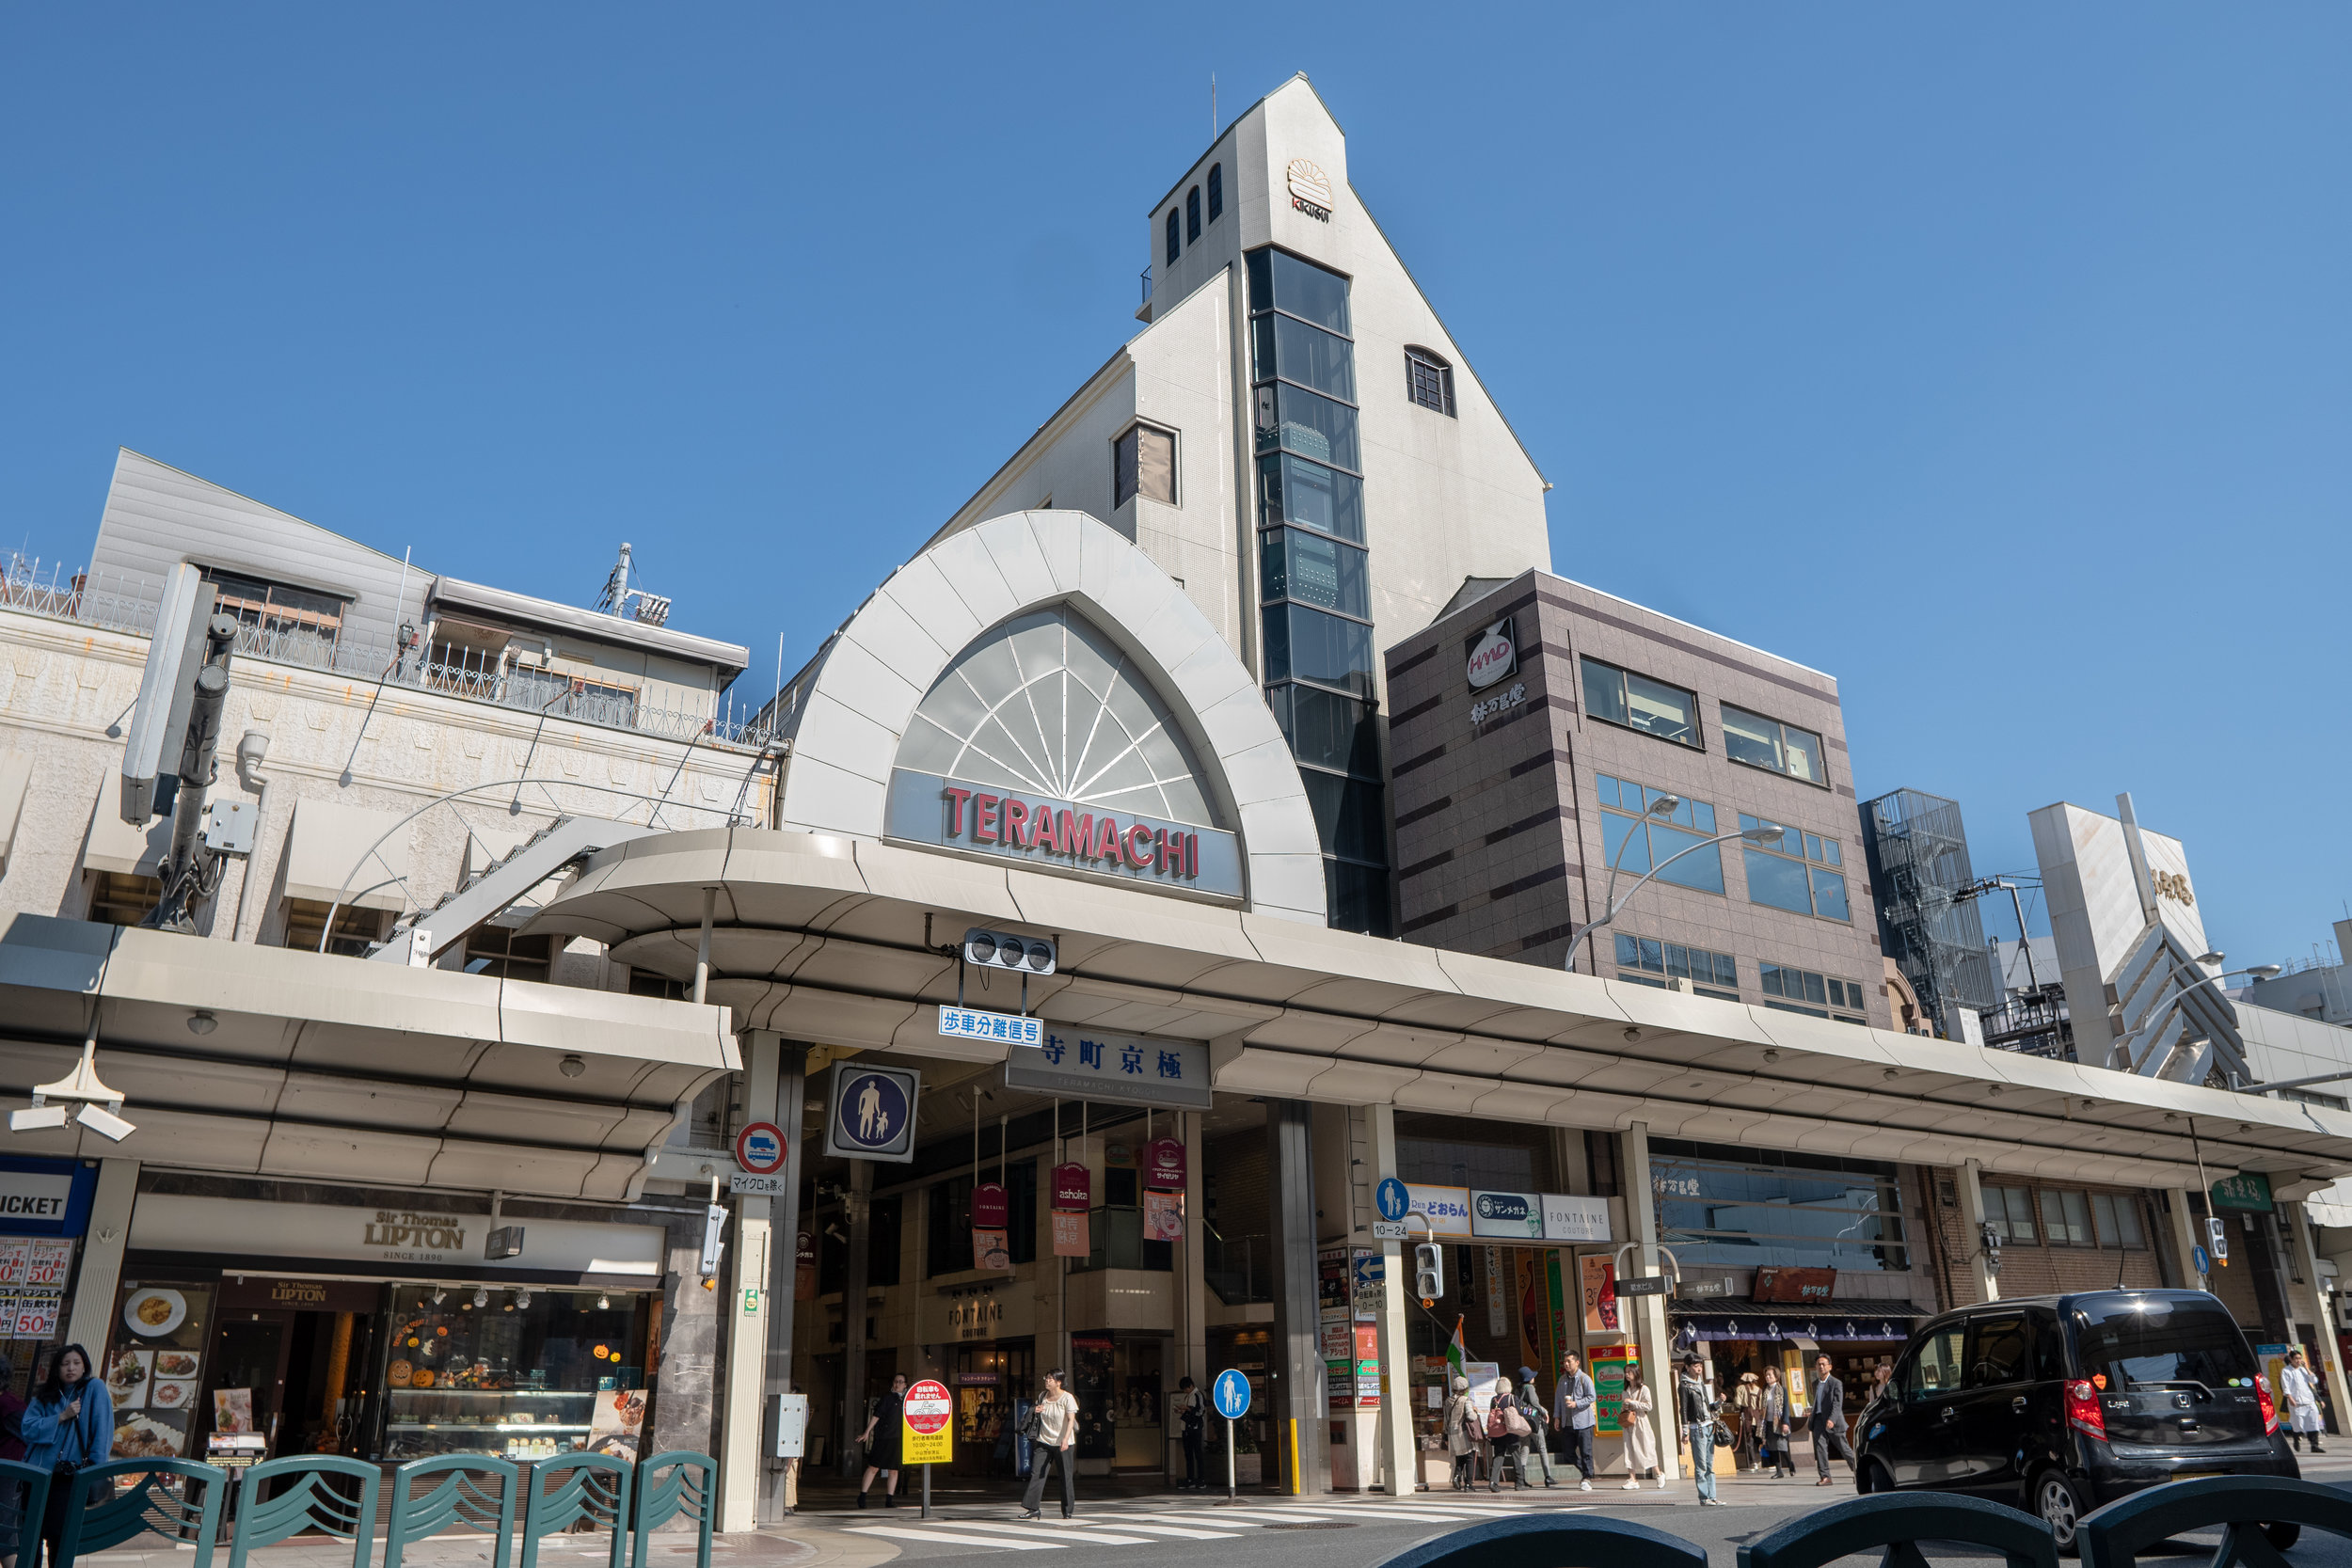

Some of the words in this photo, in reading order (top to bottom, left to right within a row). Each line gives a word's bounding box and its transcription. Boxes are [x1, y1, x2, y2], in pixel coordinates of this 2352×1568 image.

[1470, 641, 1510, 674] HMD
[946, 786, 1200, 879] TERAMACHI
[944, 1010, 1040, 1042] 歩車分離信号
[1041, 1035, 1183, 1080] 寺町京極
[733, 1176, 783, 1192] マイクロを除く
[1058, 1188, 1089, 1200] ashoka
[0, 1196, 63, 1215] ICKET
[1427, 1201, 1469, 1217] どおらん
[1494, 1205, 1527, 1215] サンメガネ
[375, 1211, 397, 1224] Sir
[402, 1212, 459, 1227] Thomas
[1549, 1212, 1604, 1224] FONTAINE
[364, 1223, 466, 1250] LIPTON
[1562, 1227, 1595, 1235] COUTURE
[383, 1251, 415, 1260] SINCE
[420, 1253, 442, 1261] 1890
[277, 1281, 290, 1290] Sir
[291, 1281, 323, 1290] Thomas
[271, 1288, 326, 1302] LIPTON
[1585, 1287, 1598, 1306] 3F
[22, 1299, 58, 1309] 缶飲料
[948, 1304, 1003, 1326] FONTAINE
[1329, 1347, 1348, 1357] アショカ
[1601, 1348, 1613, 1357] 2F
